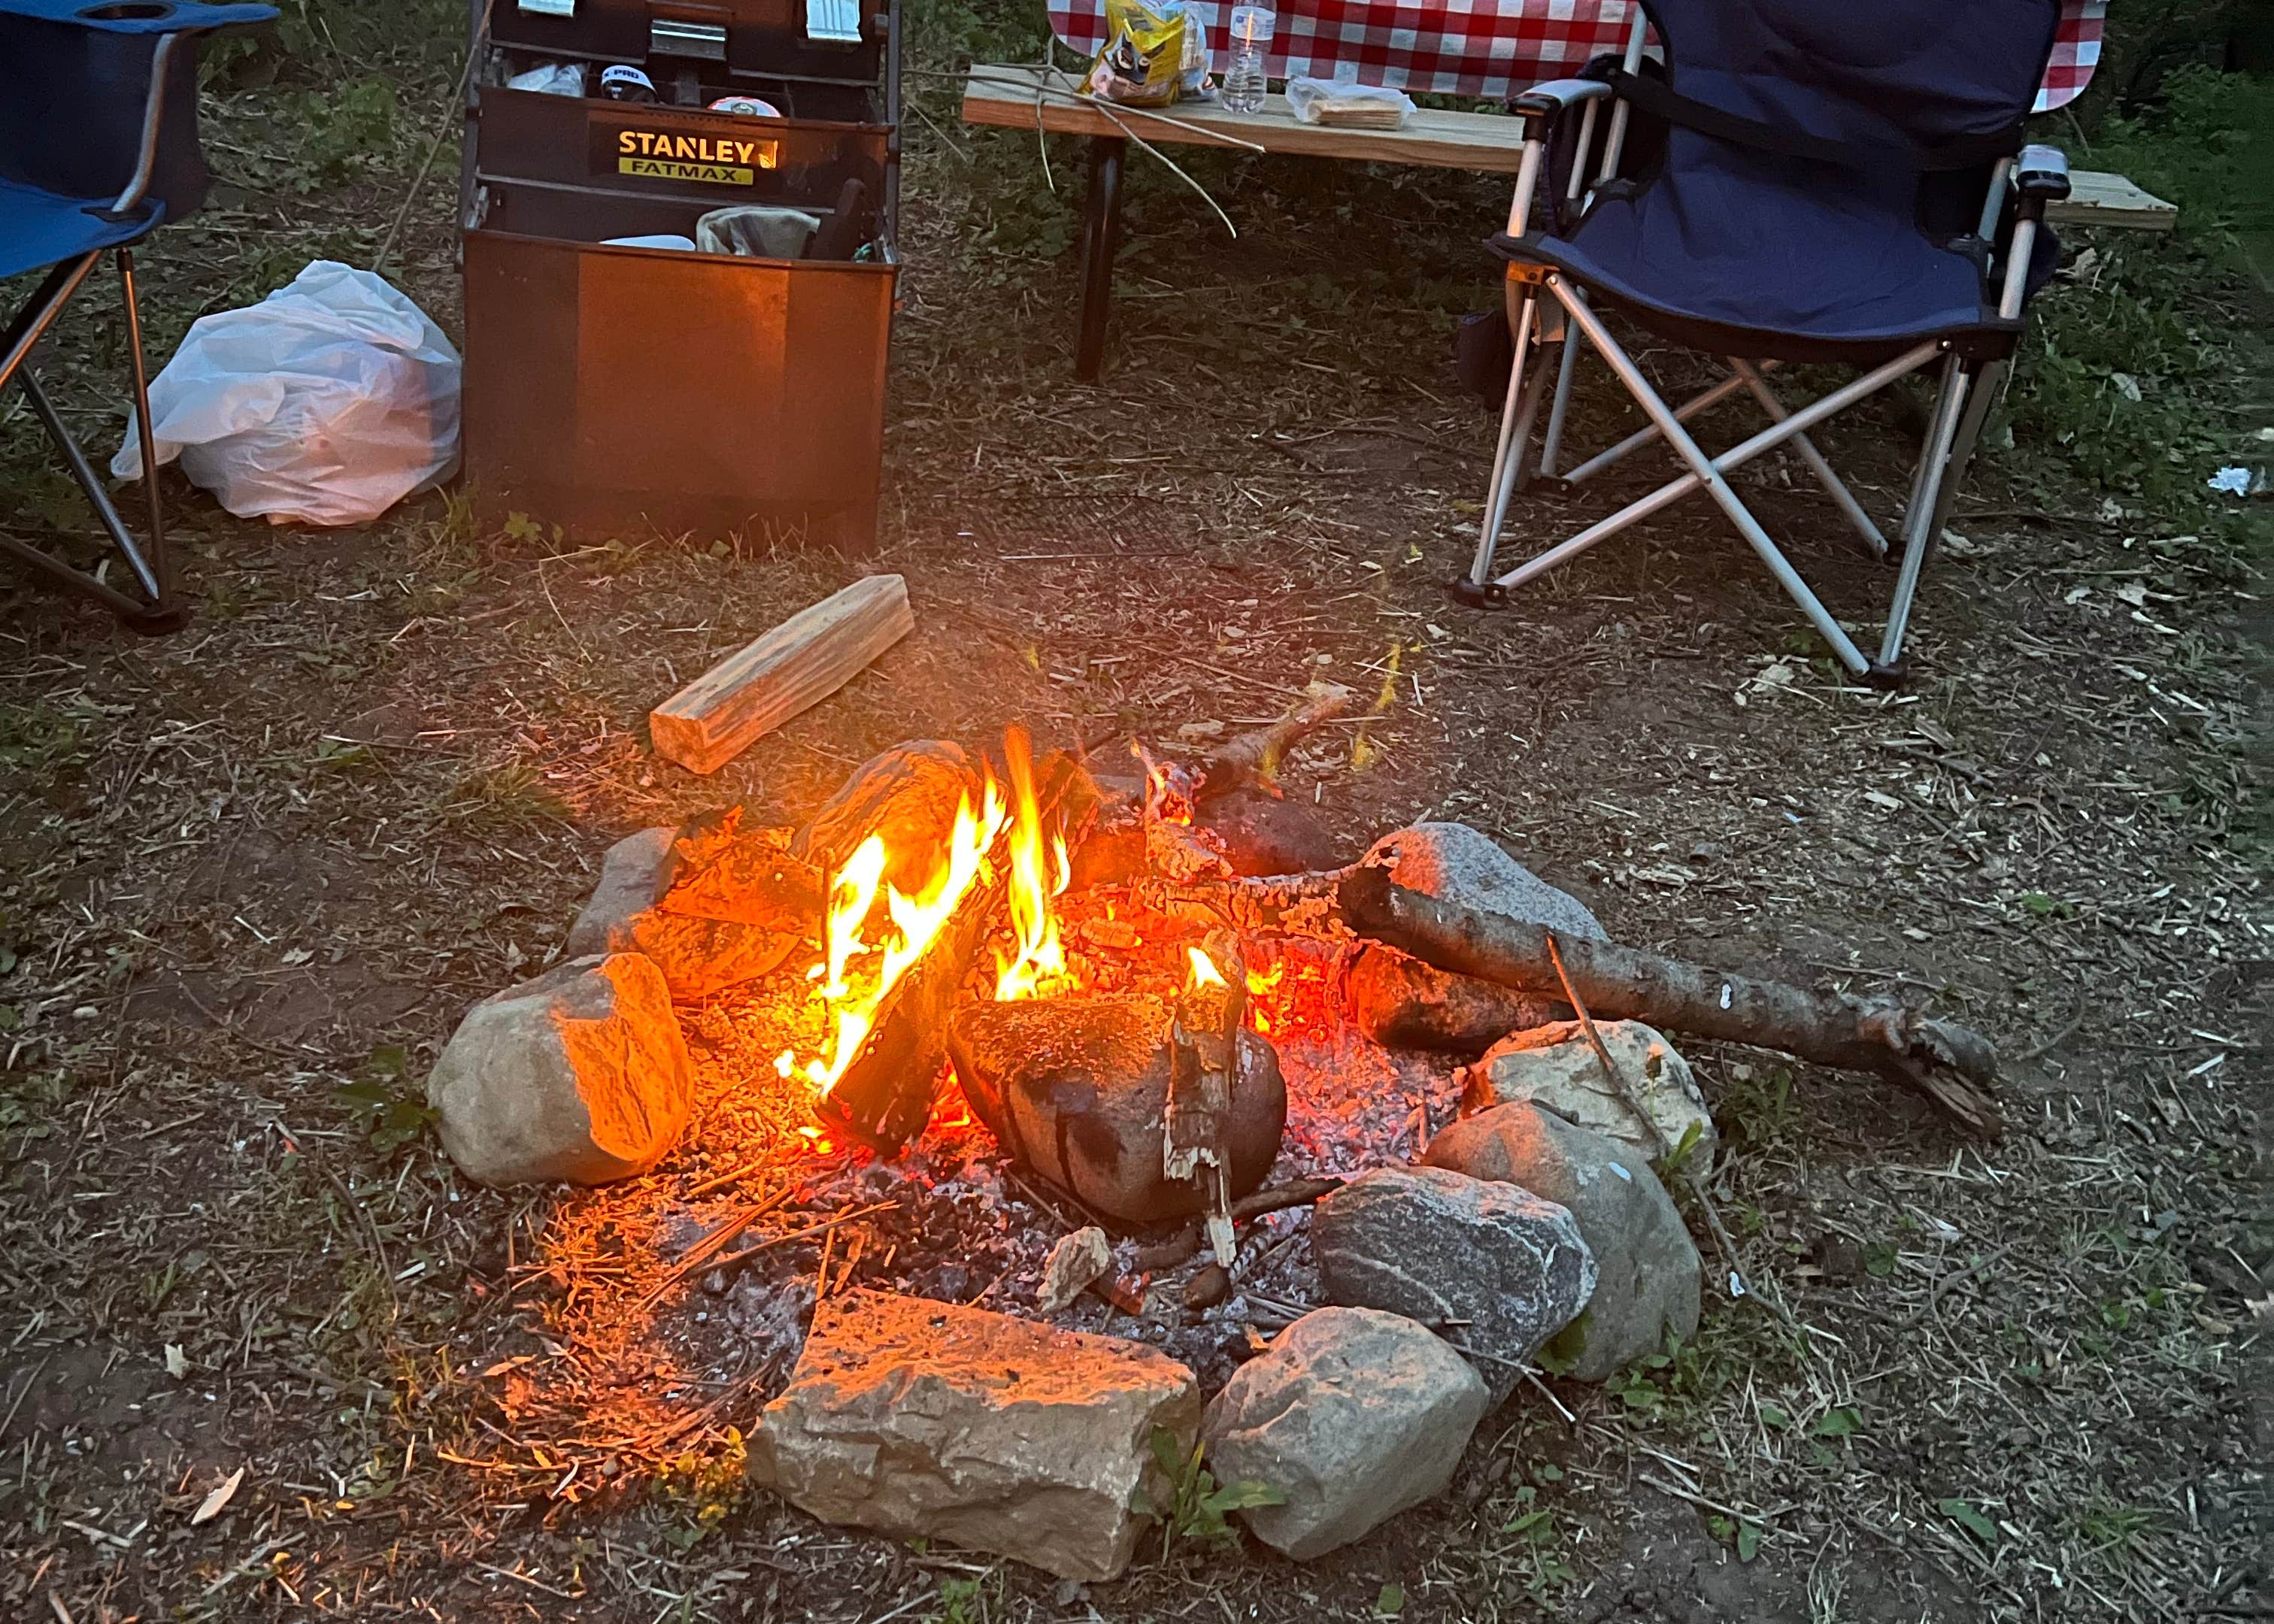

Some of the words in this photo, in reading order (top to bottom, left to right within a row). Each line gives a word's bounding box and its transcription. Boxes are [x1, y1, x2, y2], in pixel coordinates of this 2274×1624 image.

[614, 69, 639, 79] PRO
[619, 131, 754, 163] STANLEY
[632, 160, 736, 181] FATMAX
